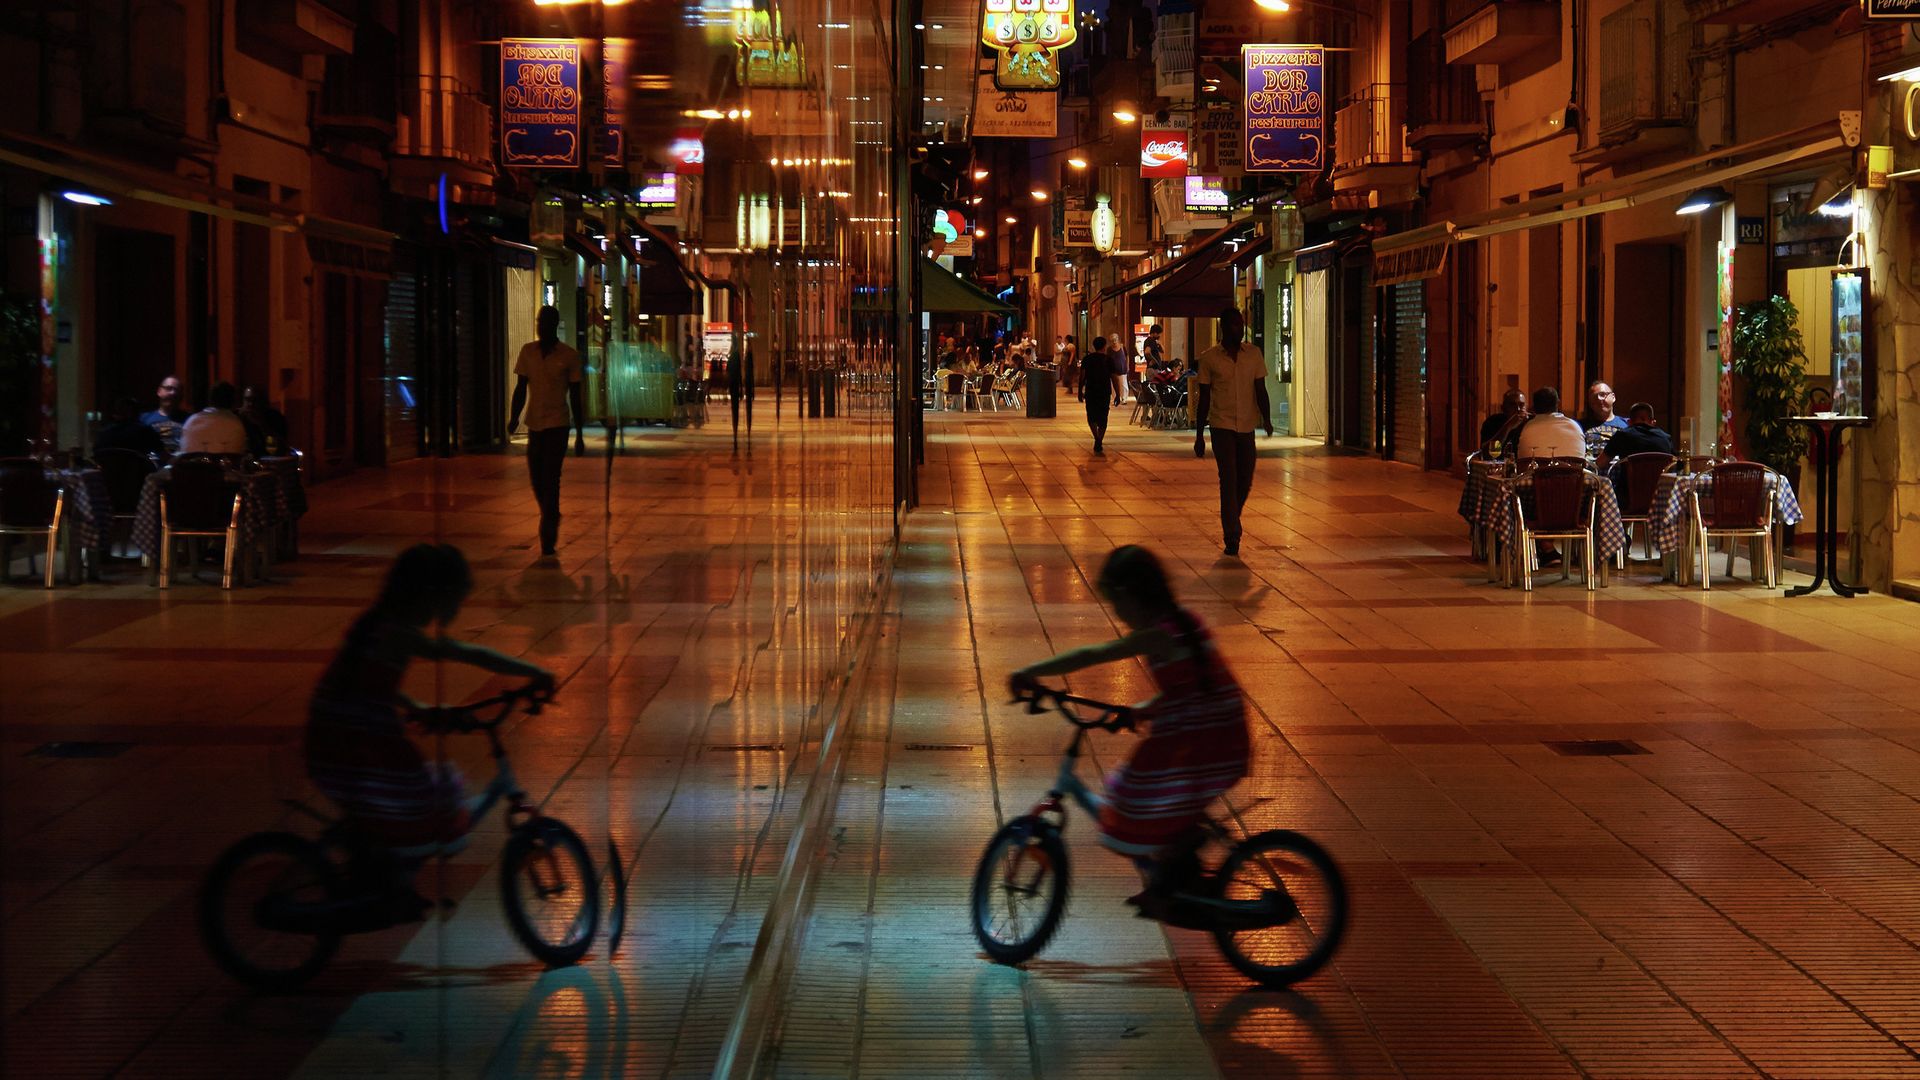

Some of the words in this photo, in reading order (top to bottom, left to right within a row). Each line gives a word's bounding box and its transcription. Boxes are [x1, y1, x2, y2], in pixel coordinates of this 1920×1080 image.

[1206, 25, 1233, 34] AGFA
[1249, 50, 1321, 70] pizzeria
[1262, 69, 1309, 92] DON
[1249, 91, 1321, 114] CARLO
[1208, 112, 1234, 121] FOTO
[1249, 115, 1321, 129] restaurant
[1173, 120, 1187, 129] BAR
[1200, 121, 1241, 130] SERVICE
[1202, 132, 1218, 173] 1
[1740, 224, 1763, 238] RB
